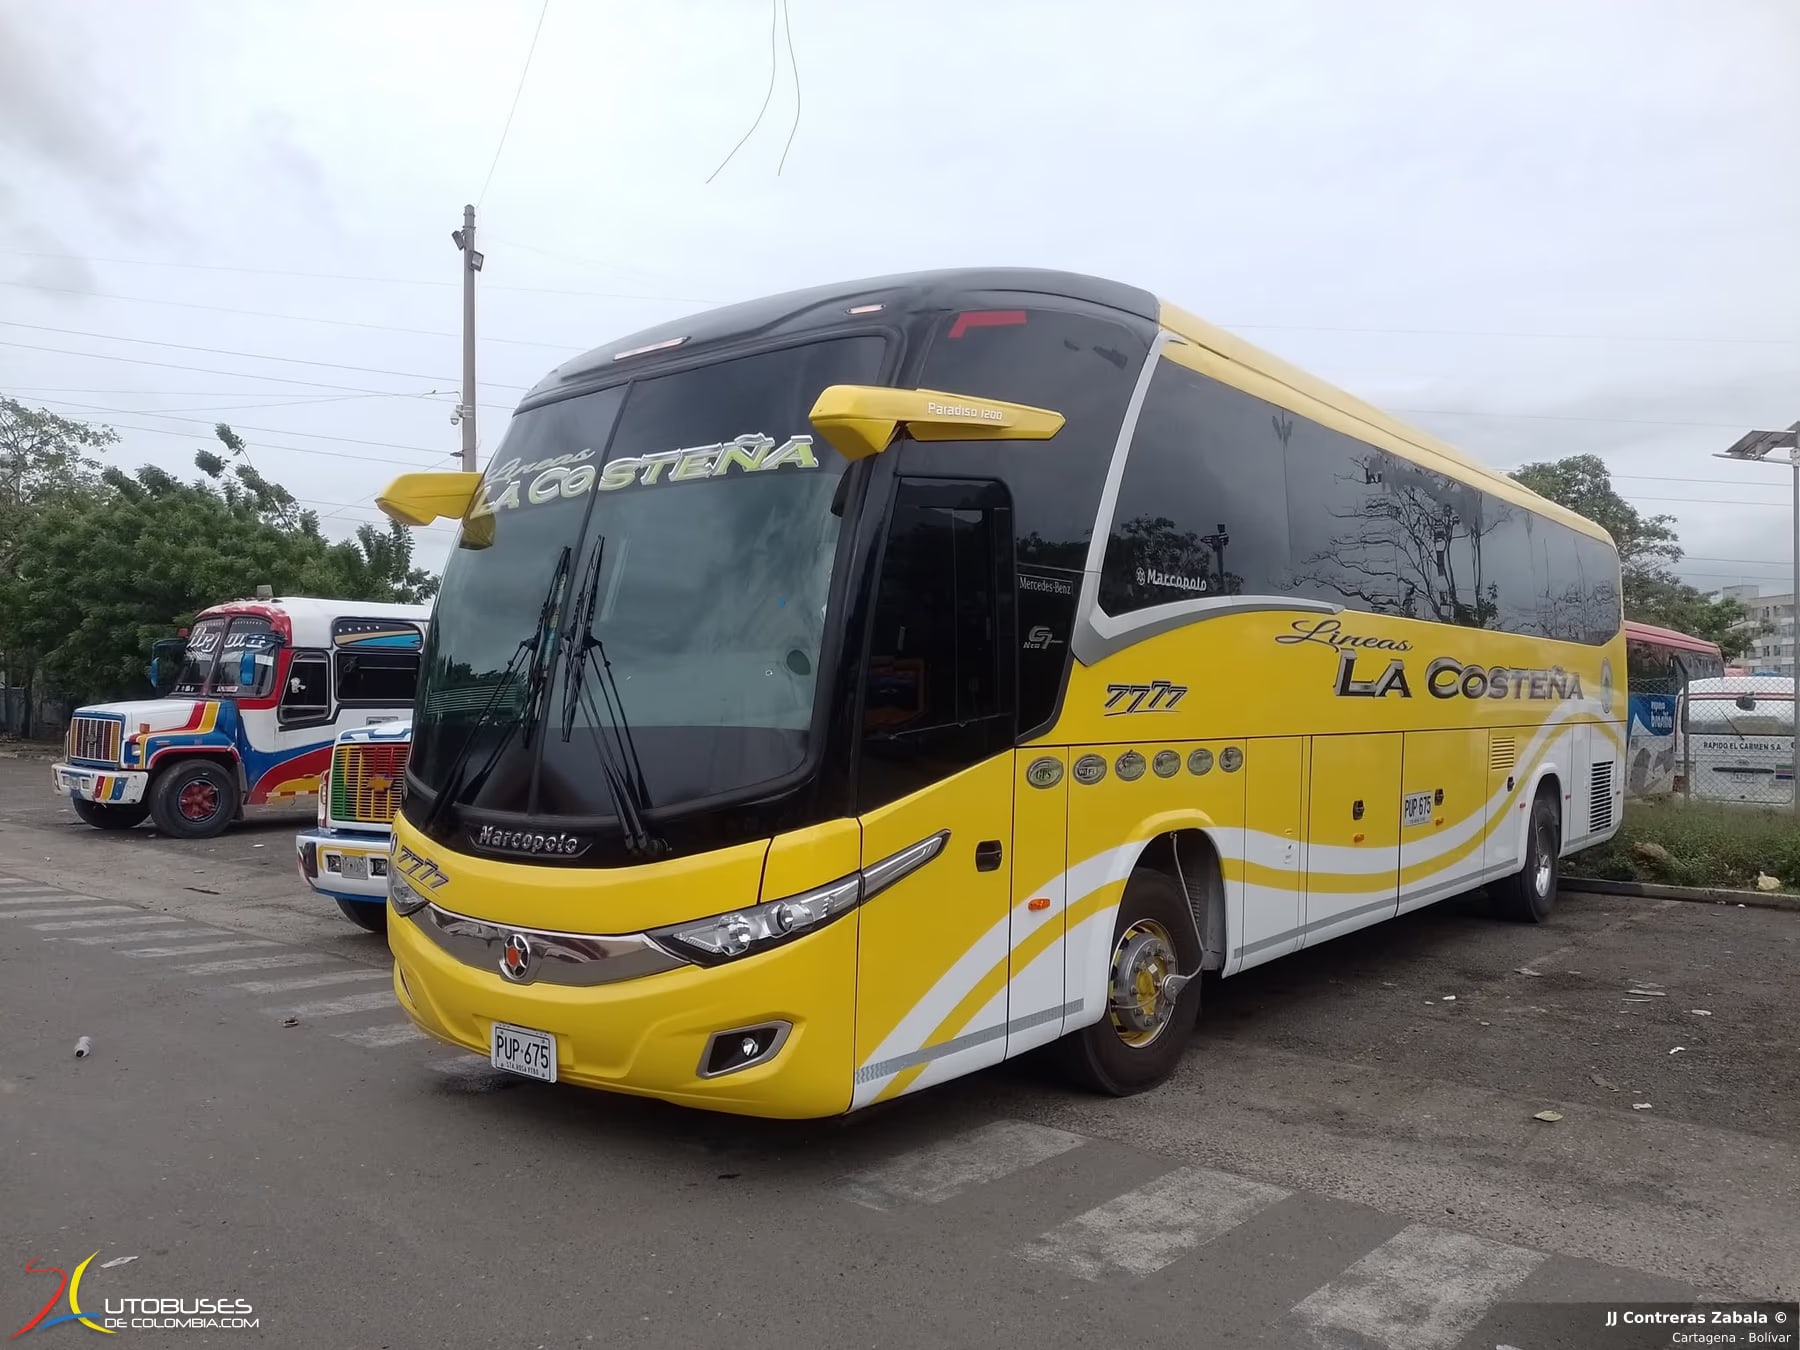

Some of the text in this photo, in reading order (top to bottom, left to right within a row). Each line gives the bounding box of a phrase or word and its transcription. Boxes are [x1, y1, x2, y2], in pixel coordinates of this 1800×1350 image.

[928, 402, 1003, 420] Paradiso 1200
[470, 432, 820, 520] LA COSTEÑA
[1019, 576, 1072, 595] Mercedes-Benz
[1147, 569, 1207, 592] Marcopolo
[1104, 680, 1188, 714] 7777
[1703, 741, 1728, 750] RAPIDO
[1739, 742, 1769, 751] CARMEN
[478, 824, 578, 855] Marcopolo
[398, 845, 449, 889] 7777
